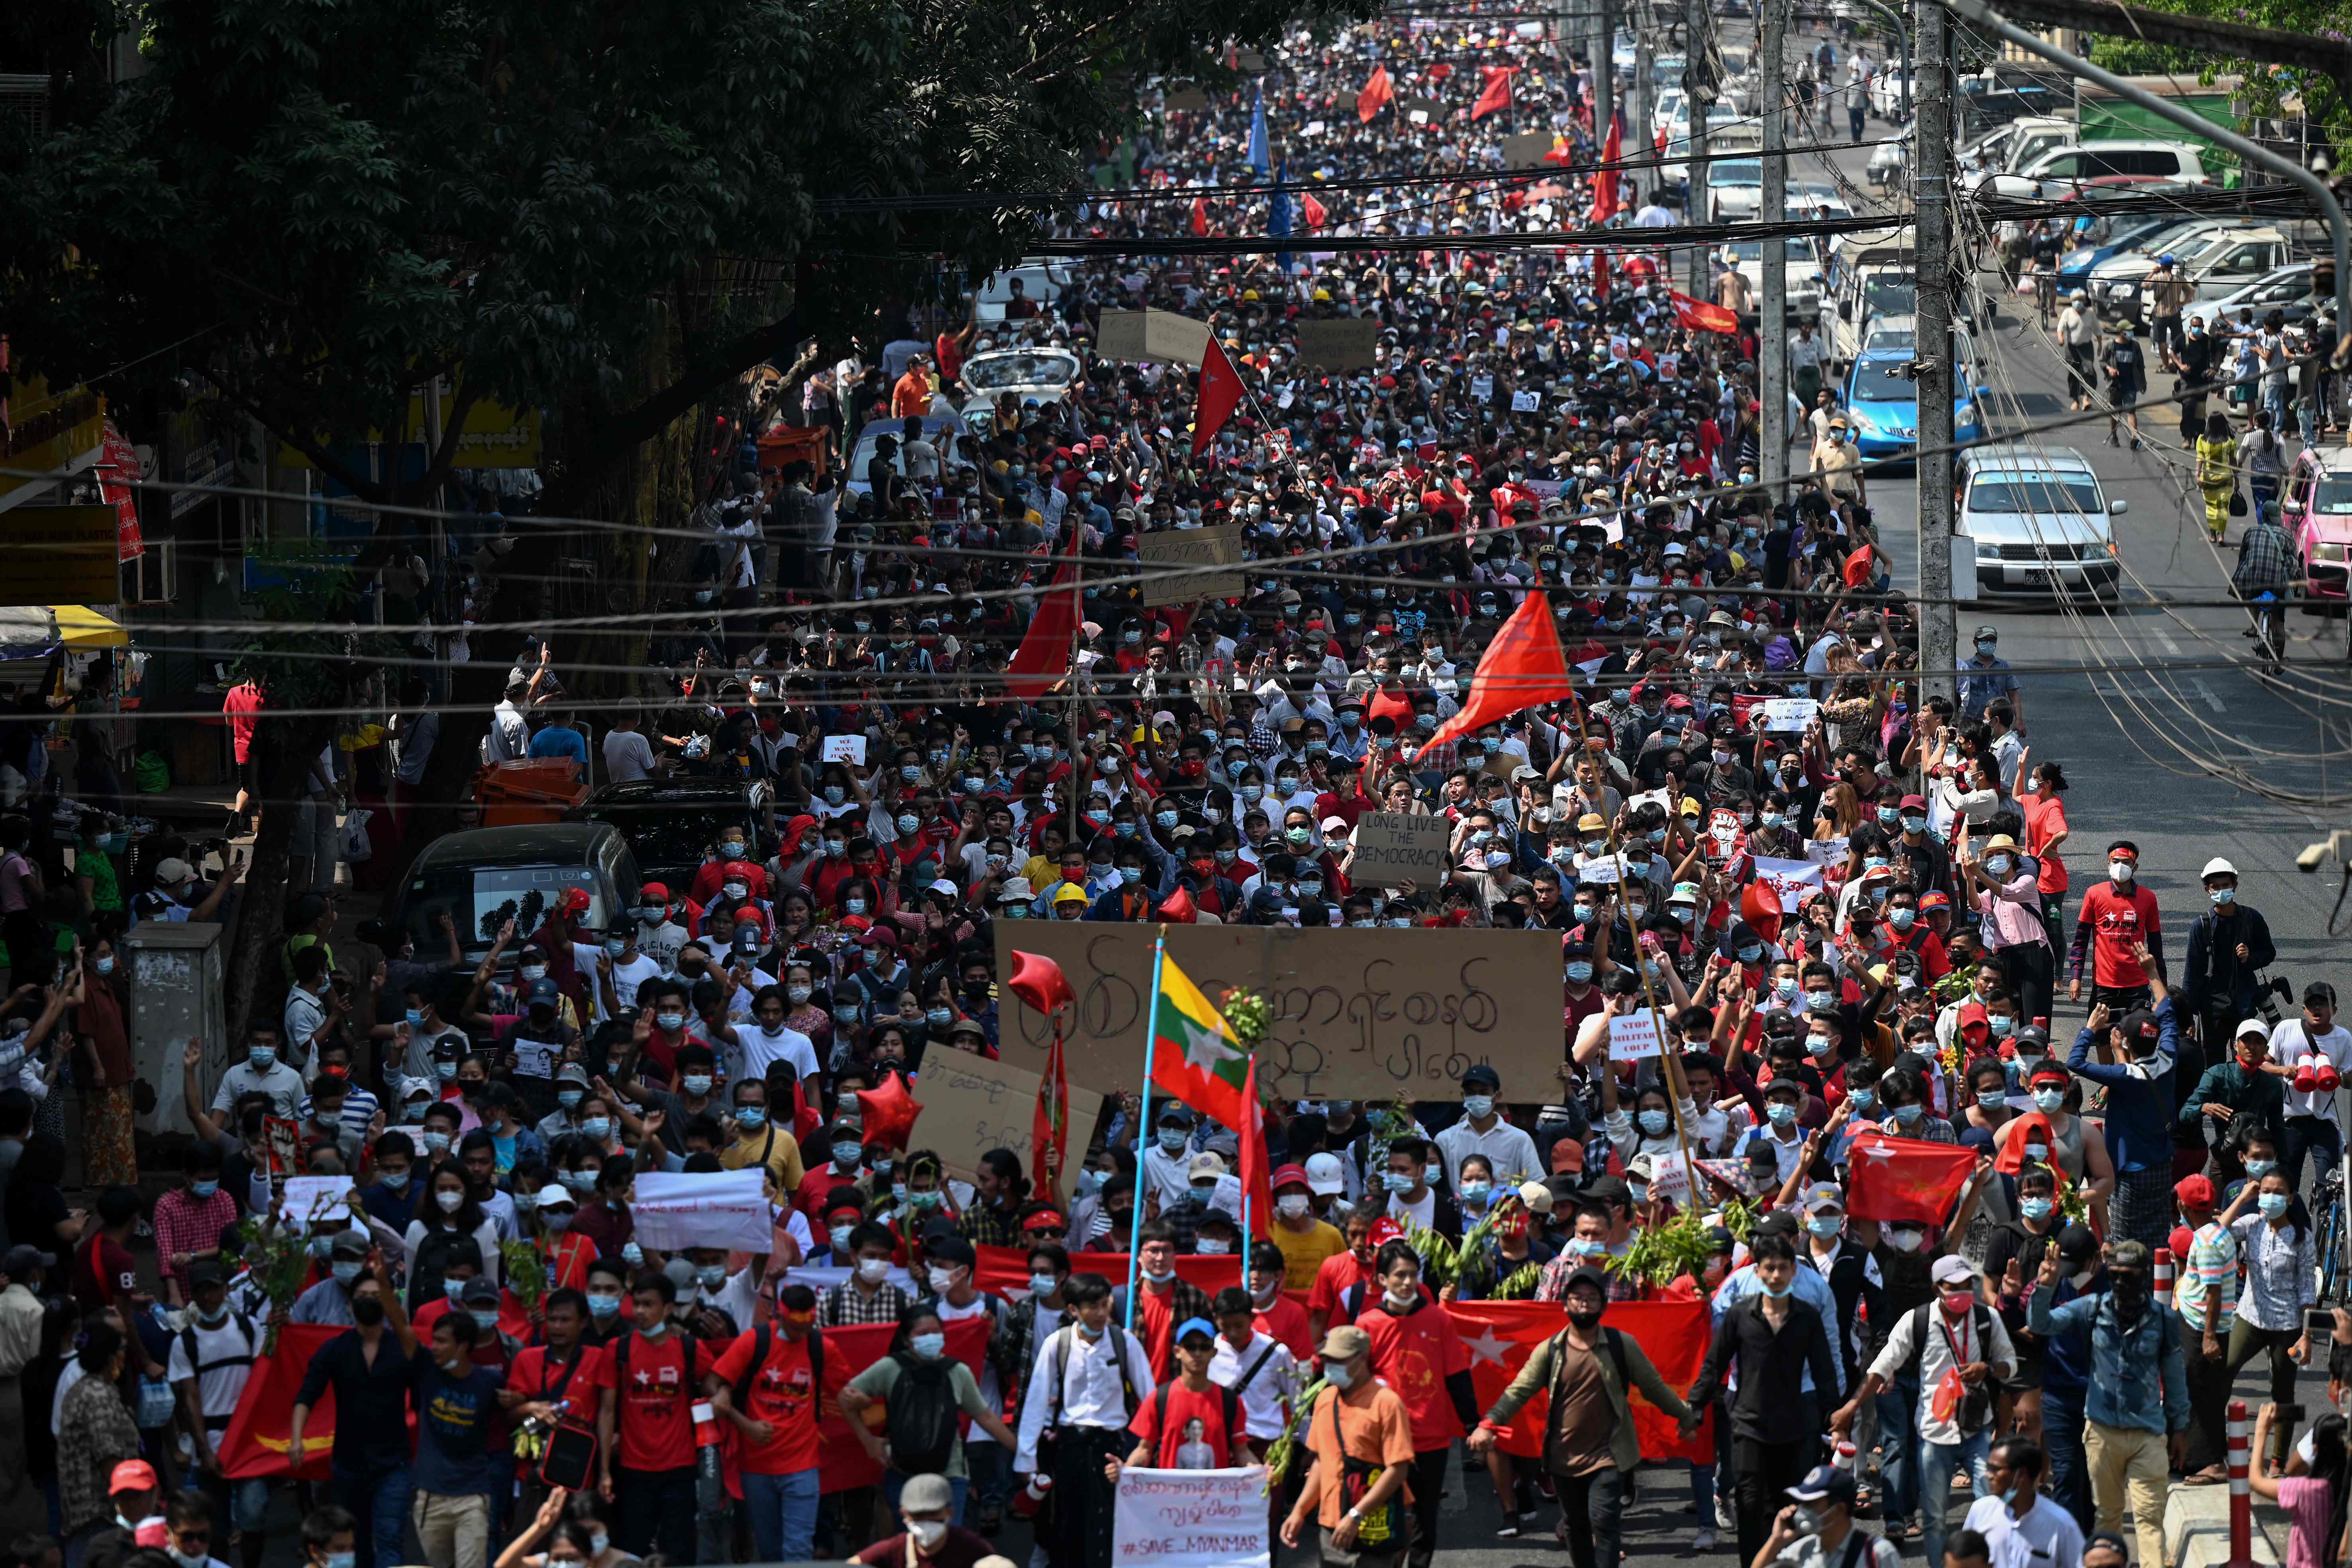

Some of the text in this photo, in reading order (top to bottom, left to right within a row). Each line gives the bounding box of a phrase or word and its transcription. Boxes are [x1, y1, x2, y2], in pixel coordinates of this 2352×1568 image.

[1366, 814, 1439, 832] LONG LIVE
[1389, 831, 1414, 844] THE
[1355, 846, 1445, 869] DEMOCRACY
[633, 940, 680, 955] CHICAGO
[1622, 1020, 1649, 1029] STOP
[1624, 1043, 1649, 1052] COUP
[1658, 1171, 1682, 1180] WANT
[670, 1199, 697, 1213] need
[1123, 1534, 1259, 1555] #SAVE_MYANMAR
